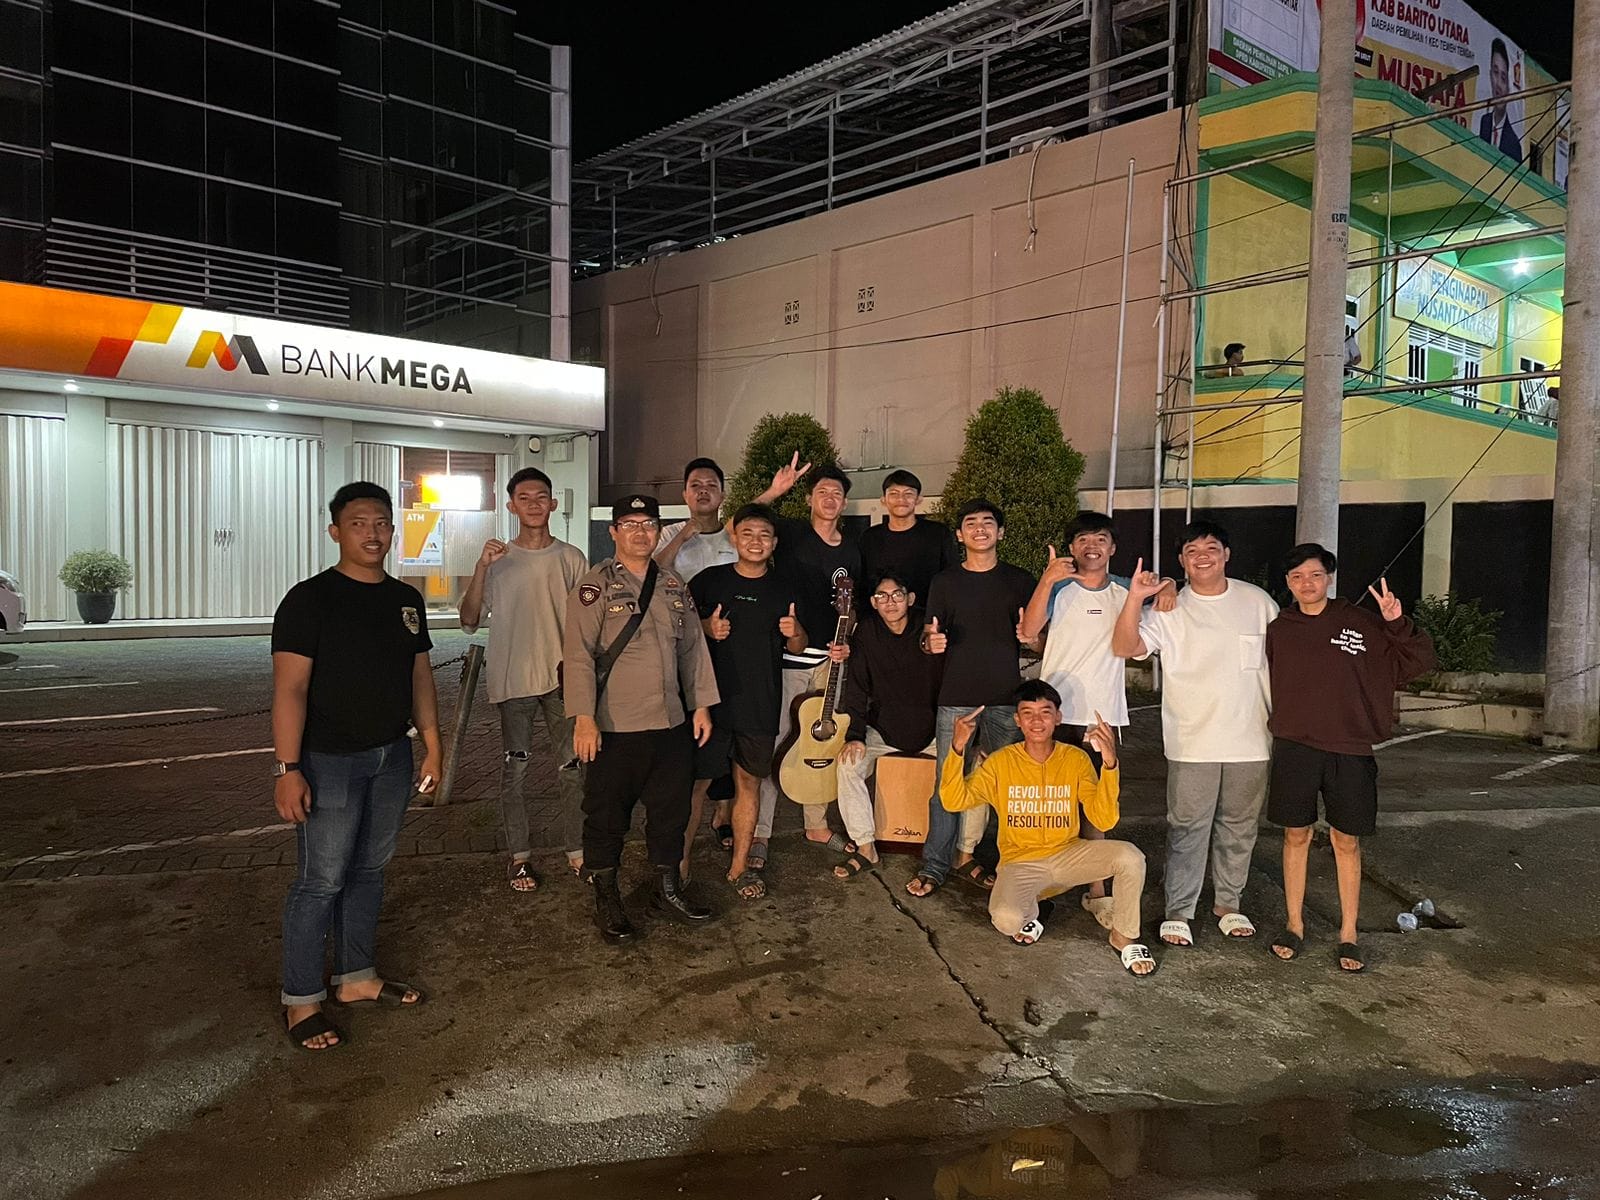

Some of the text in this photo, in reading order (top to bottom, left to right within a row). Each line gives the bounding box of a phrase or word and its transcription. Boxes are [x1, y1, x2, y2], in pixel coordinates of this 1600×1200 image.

[1371, 0, 1469, 45] KAB BARITO UTARA
[1372, 16, 1395, 34] DAERAH
[1431, 269, 1489, 309] PENGINAPAN
[406, 513, 425, 522] ATM
[1008, 785, 1070, 799] REVOLUTION
[1007, 800, 1070, 813] REVOLUTION
[1007, 815, 1070, 828] RESOLUTION
